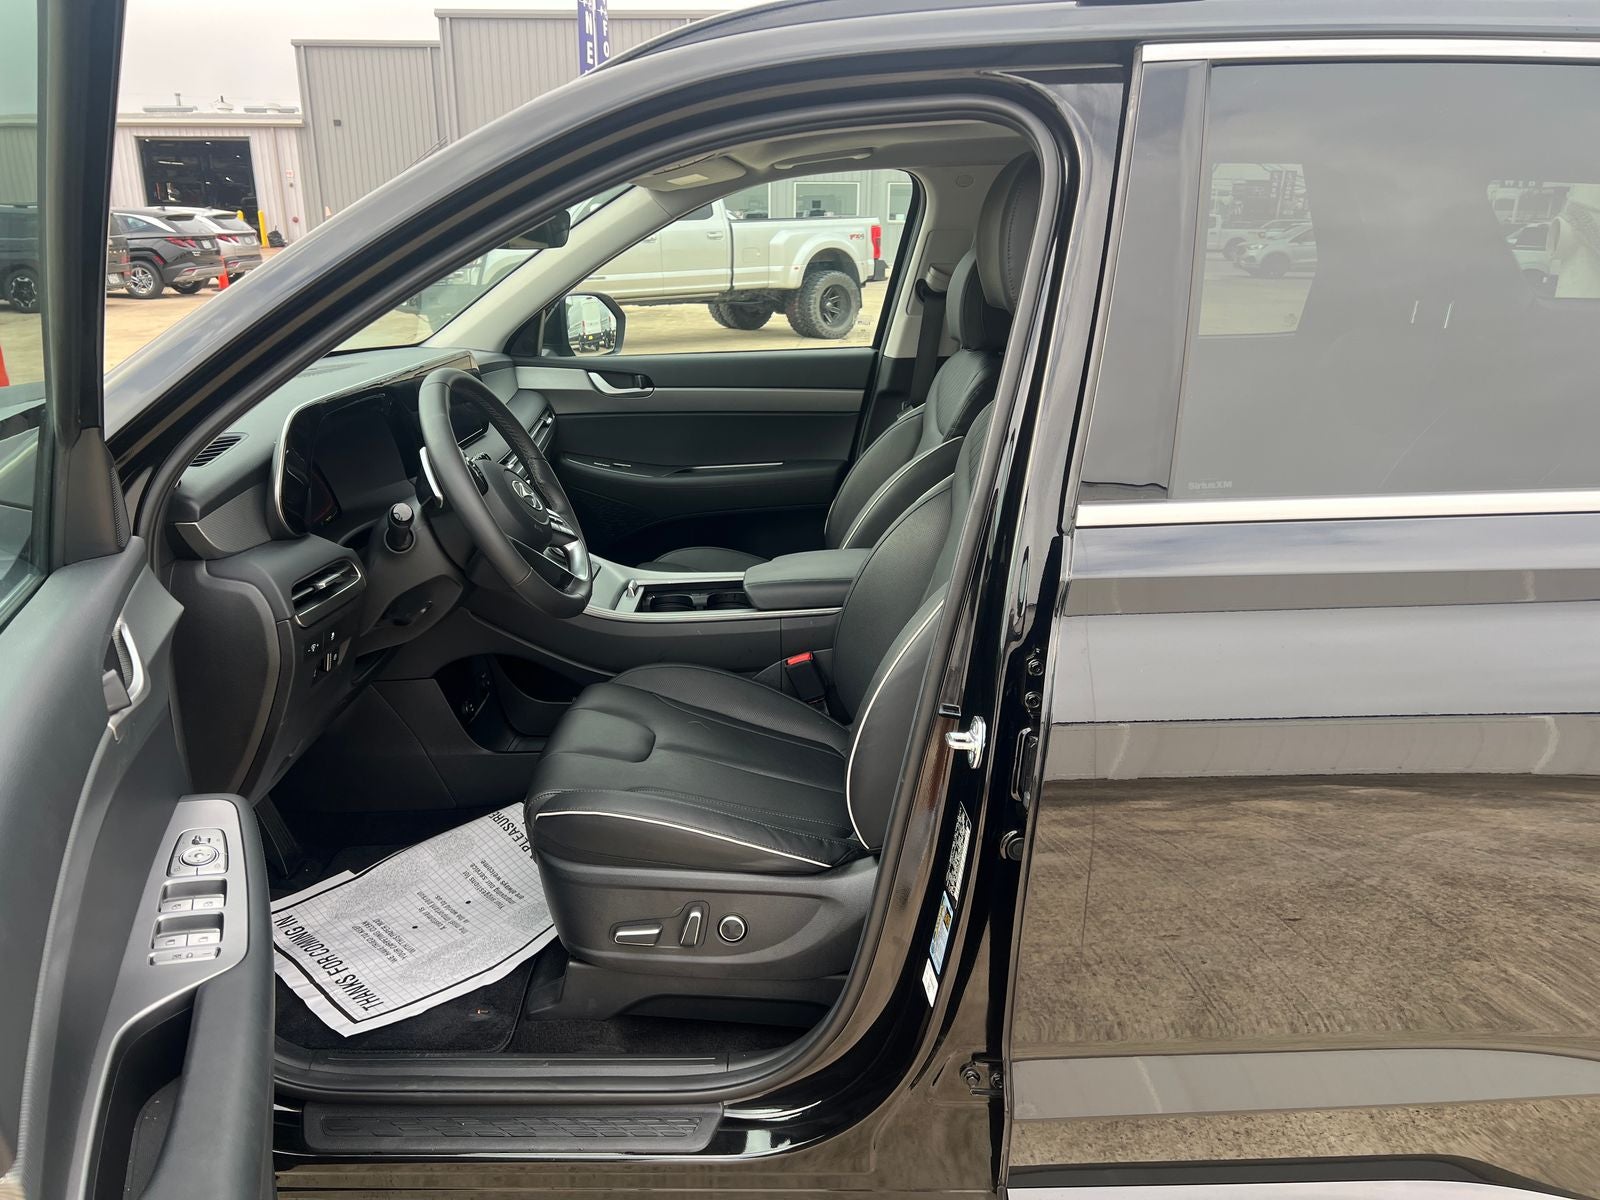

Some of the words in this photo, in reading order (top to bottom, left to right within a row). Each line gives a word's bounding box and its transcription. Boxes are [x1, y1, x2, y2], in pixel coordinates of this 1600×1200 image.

[1187, 480, 1232, 490] SiriusXM
[488, 812, 530, 852] PLEASURE
[274, 915, 298, 929] IN
[285, 926, 330, 957] COMING
[317, 954, 349, 976] FOR
[335, 974, 384, 1011] THANKS
